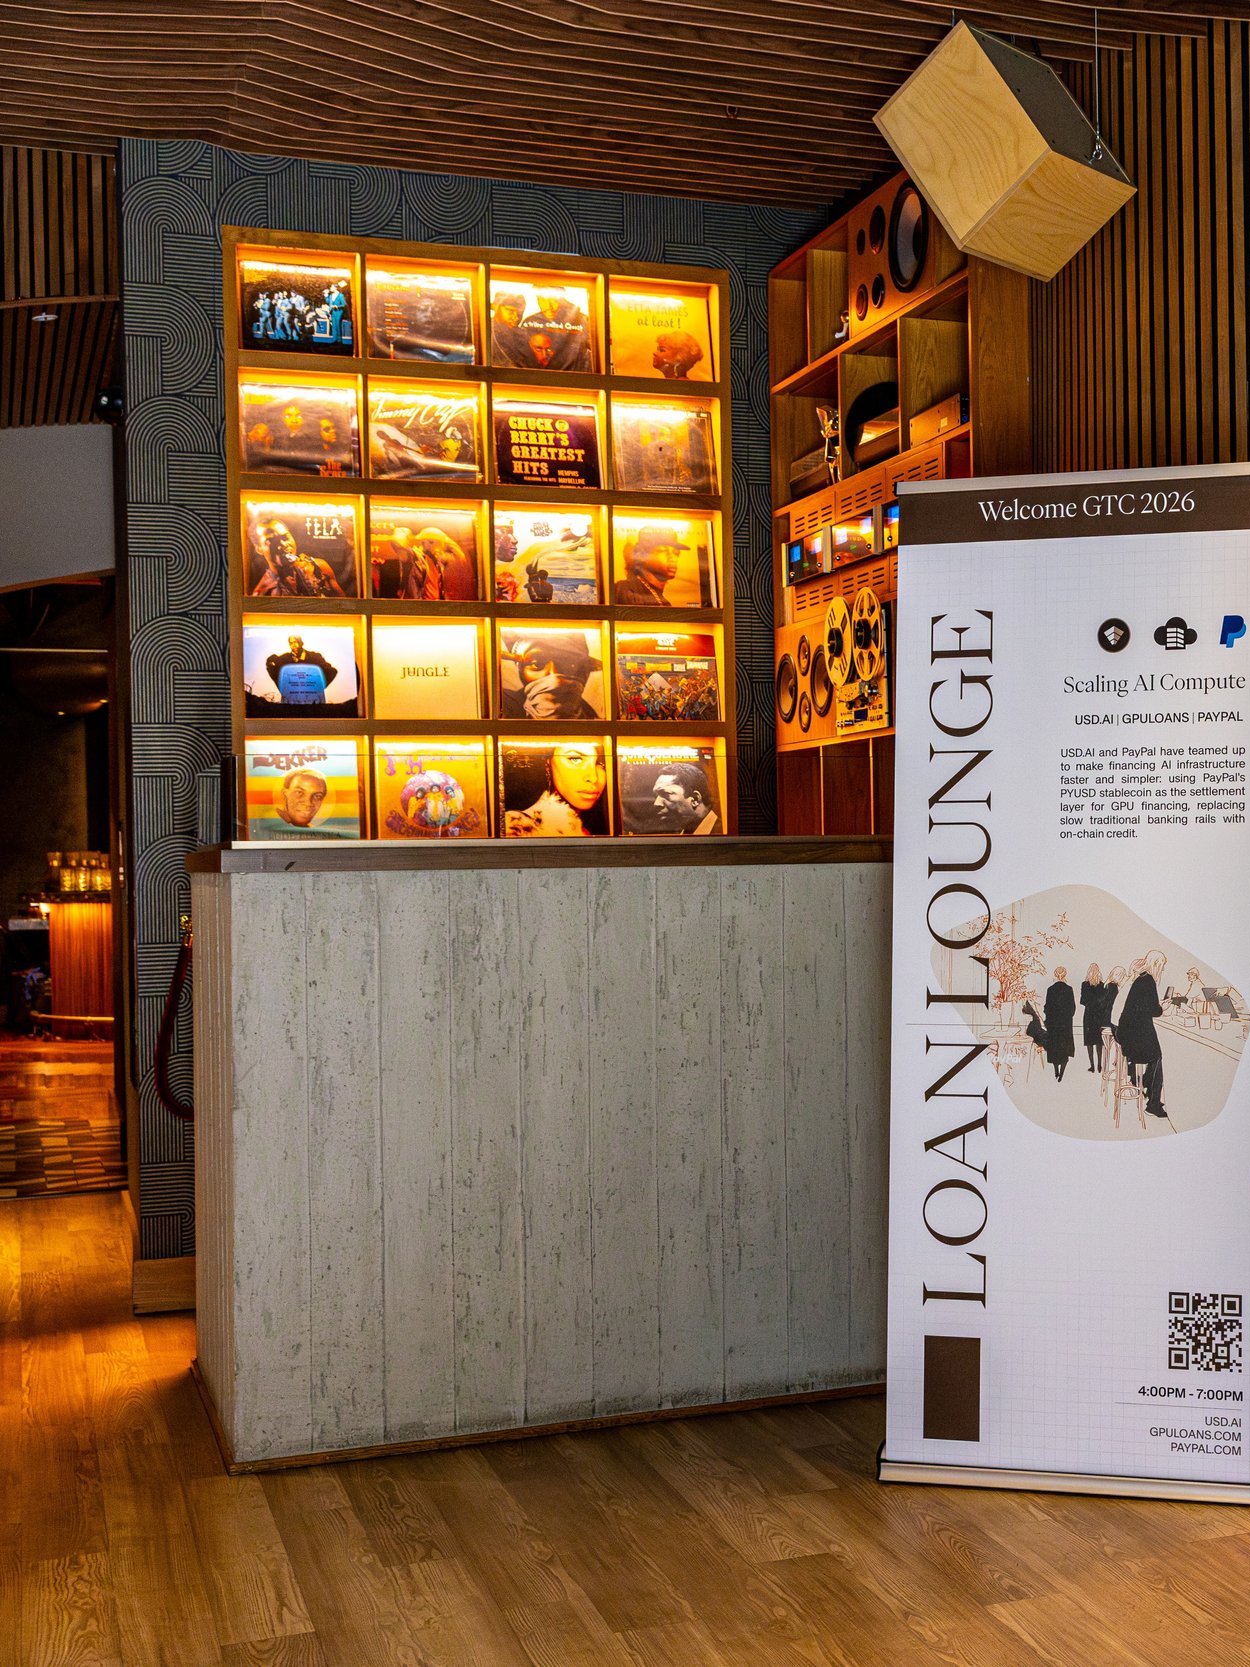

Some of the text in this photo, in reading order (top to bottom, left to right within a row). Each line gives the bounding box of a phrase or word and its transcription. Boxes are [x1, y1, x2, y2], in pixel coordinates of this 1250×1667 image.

[652, 317, 674, 328] last
[372, 400, 421, 428] Jimmy
[509, 416, 554, 431] CHUCK
[510, 431, 569, 446] BERRY'S
[511, 445, 585, 462] GREATEST
[512, 460, 549, 475] HITS
[978, 491, 1194, 521] Welcome GTC 2026
[305, 518, 342, 536] FELA
[401, 667, 449, 679] JUNGLE
[1064, 674, 1245, 697] Scaling AI Compute
[1075, 712, 1243, 725] USD.AI GPULOANS PAYPAL
[253, 745, 328, 770] DEKKER
[1061, 746, 1245, 758] USD.AI and PayPal have teamed up
[1061, 760, 1245, 771] to make financing AI infrastructure
[1061, 773, 1245, 785] faster and simpler: using PayPal's
[1061, 789, 1096, 798] PYUSD
[1100, 788, 1151, 797] stablecoin
[1170, 788, 1186, 796] the
[1190, 787, 1245, 796] settlement
[1061, 801, 1245, 813] layer for GPU financing, replacing
[1060, 814, 1245, 825] slow traditional banking rails with
[1060, 829, 1138, 838] on-chain credit.
[923, 608, 995, 1309] LOAN LOUNGE
[1138, 1386, 1185, 1398] 4:00PM
[1197, 1389, 1243, 1401] 7:00PM
[1205, 1416, 1241, 1427] USD.AI
[1150, 1427, 1241, 1441] GPULOANS.COM
[1171, 1442, 1241, 1455] PAYPAL.COM
